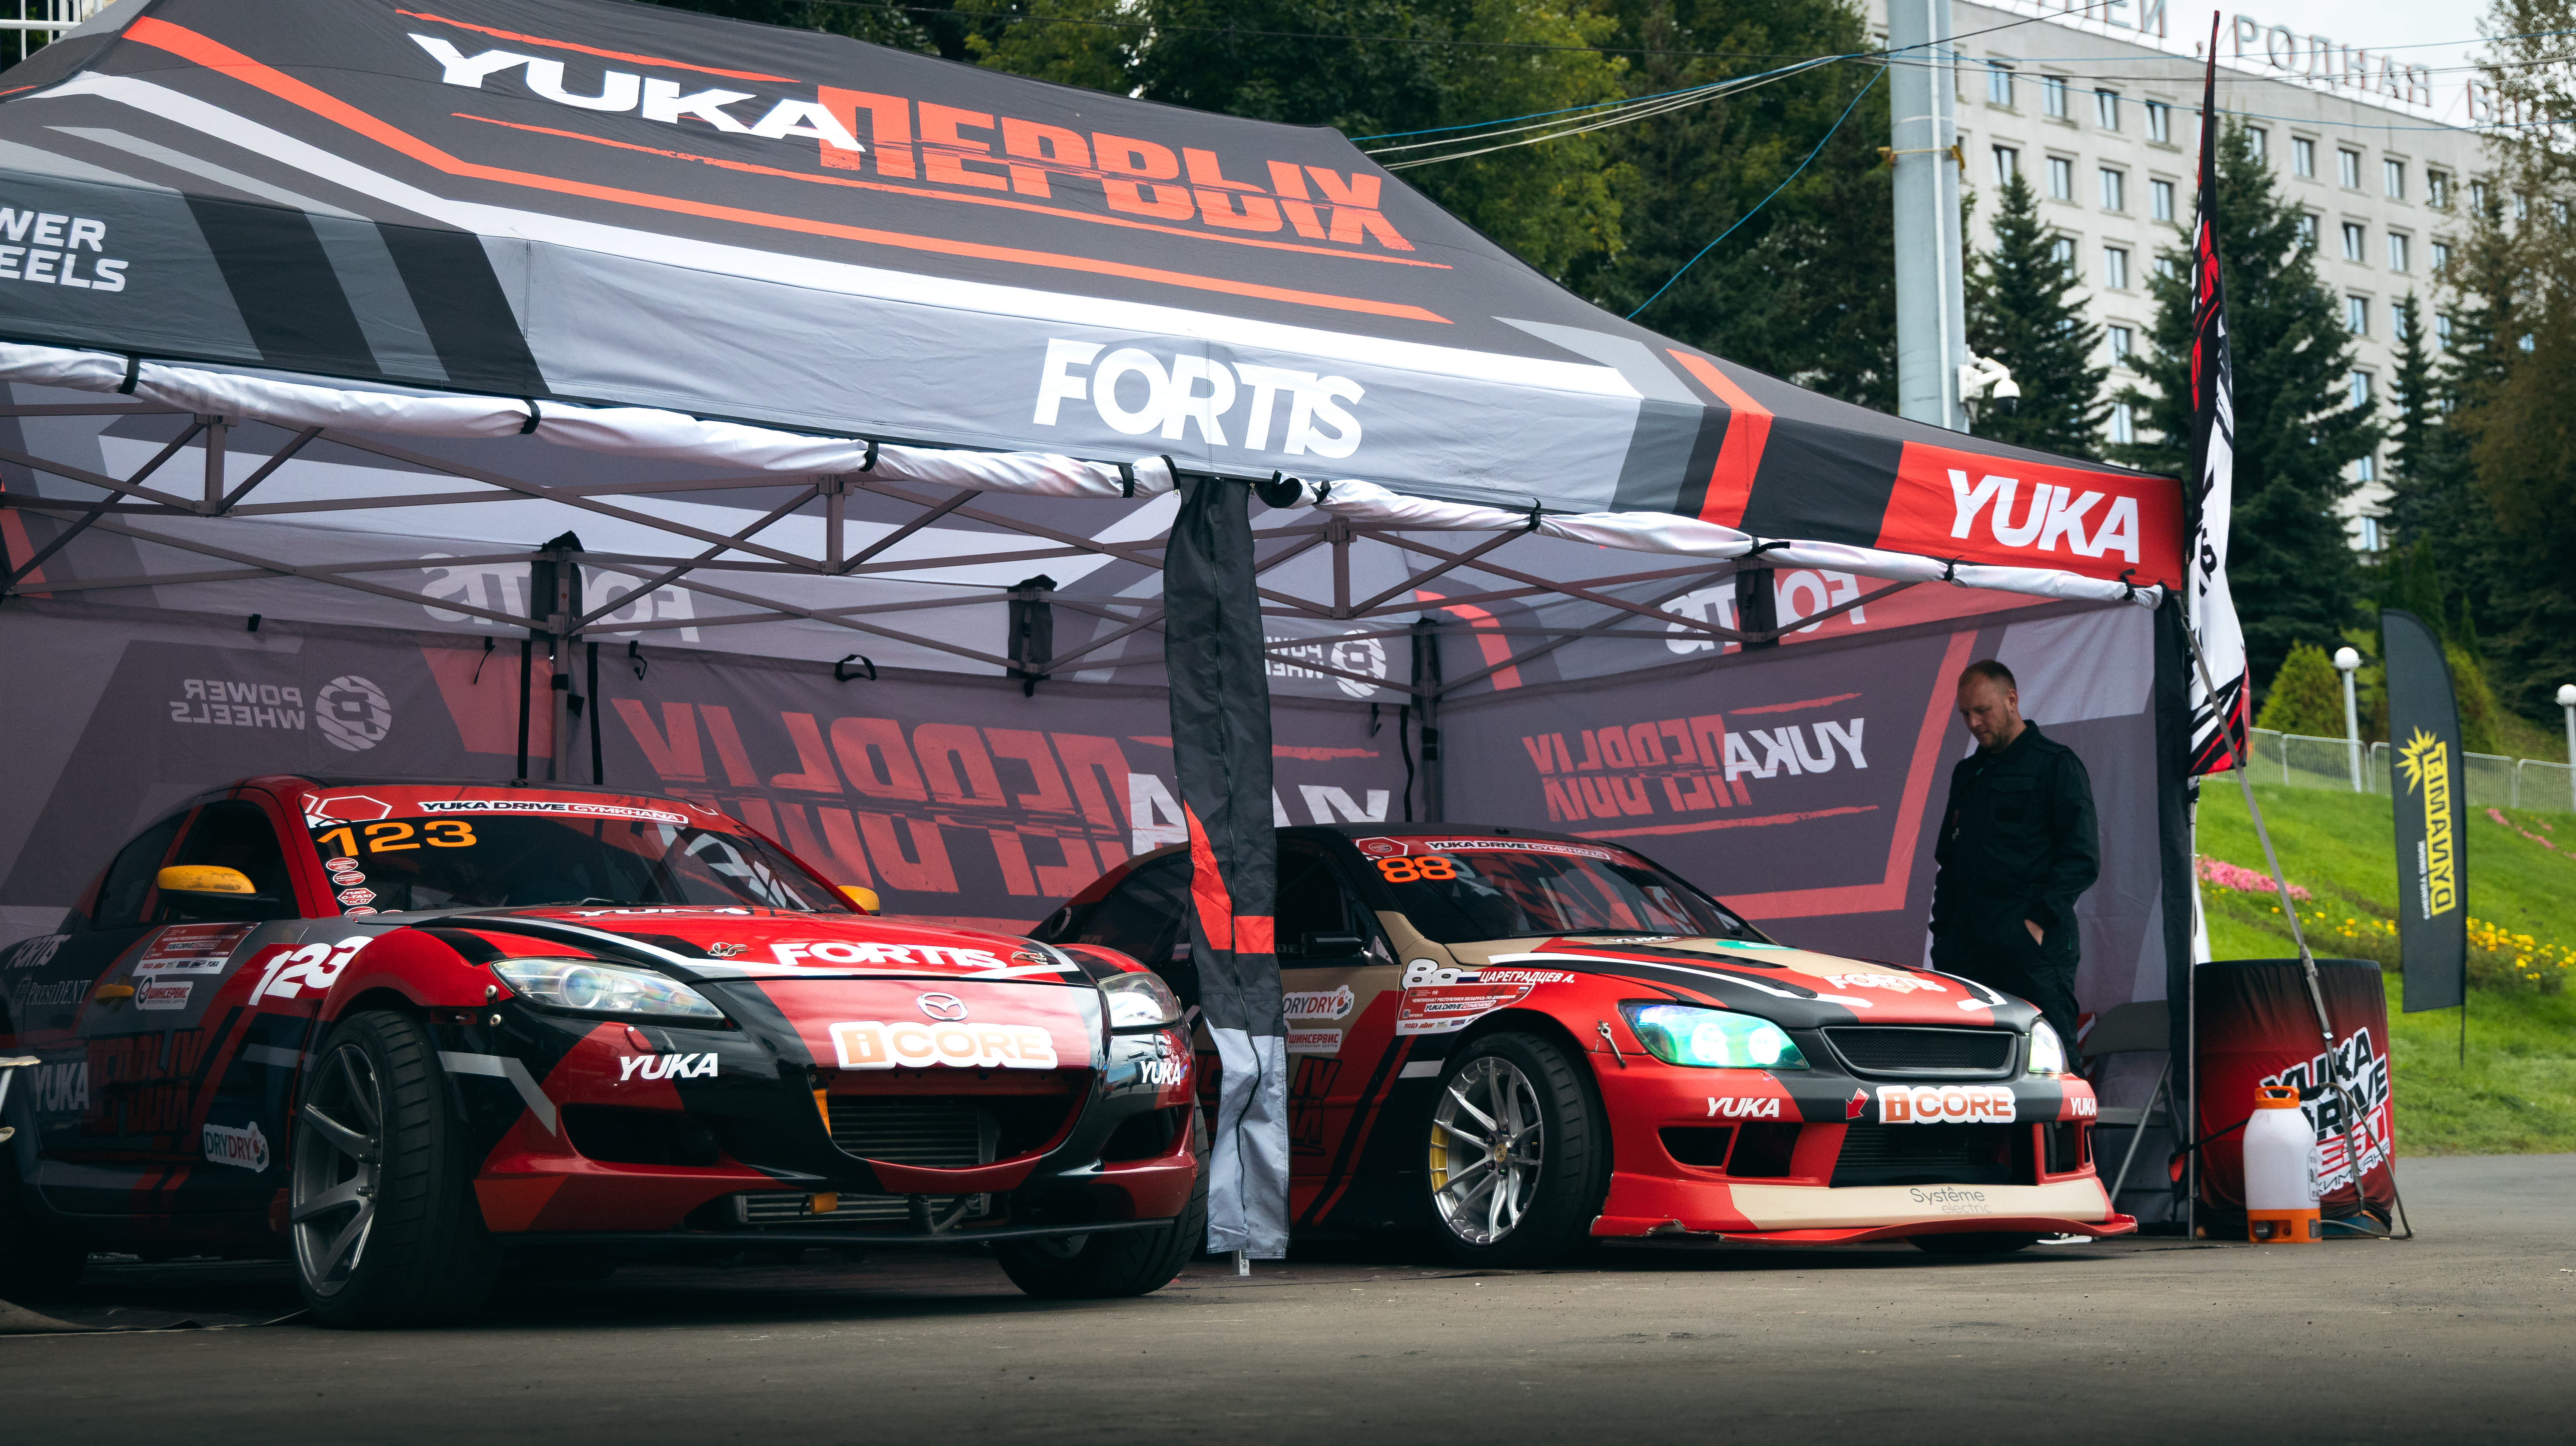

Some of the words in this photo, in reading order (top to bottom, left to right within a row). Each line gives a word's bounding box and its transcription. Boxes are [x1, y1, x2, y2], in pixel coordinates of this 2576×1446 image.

[2234, 15, 2431, 107] РОДНАЯ
[408, 33, 865, 153] YUKA
[0, 209, 106, 252] WER
[0, 246, 129, 292] EELS
[1033, 337, 1366, 459] FORTIS
[1947, 468, 2140, 564] YUKA
[423, 802, 489, 811] YUKA
[493, 802, 566, 811] DRIVE
[573, 805, 680, 821] GYMKHANA
[317, 820, 477, 857] 123
[1531, 845, 1604, 857] GYMKHANA
[1377, 856, 1456, 883] 88
[569, 907, 750, 917] YUKA
[770, 942, 1007, 969] FORTIS
[248, 936, 374, 1006] 123
[1479, 971, 1561, 984] ЦАРЕГРАДЦЕВ
[1822, 973, 1947, 992] FORTIS
[26, 980, 92, 1005] PRESIDENT
[148, 987, 190, 999] ШИНСЕРВИС
[1288, 1033, 1340, 1044] ШИНСЕРВИС
[619, 1053, 718, 1080] YUKA
[1140, 1060, 1181, 1086] YUKA
[34, 1061, 90, 1112] YUKA
[2302, 1058, 2389, 1140] RIVE
[1706, 1097, 1780, 1118] YUKA
[2070, 1097, 2097, 1117] YUKA
[205, 1132, 252, 1161] DRYDRY
[2317, 1105, 2387, 1178] EST
[1942, 1202, 1993, 1213] electric
